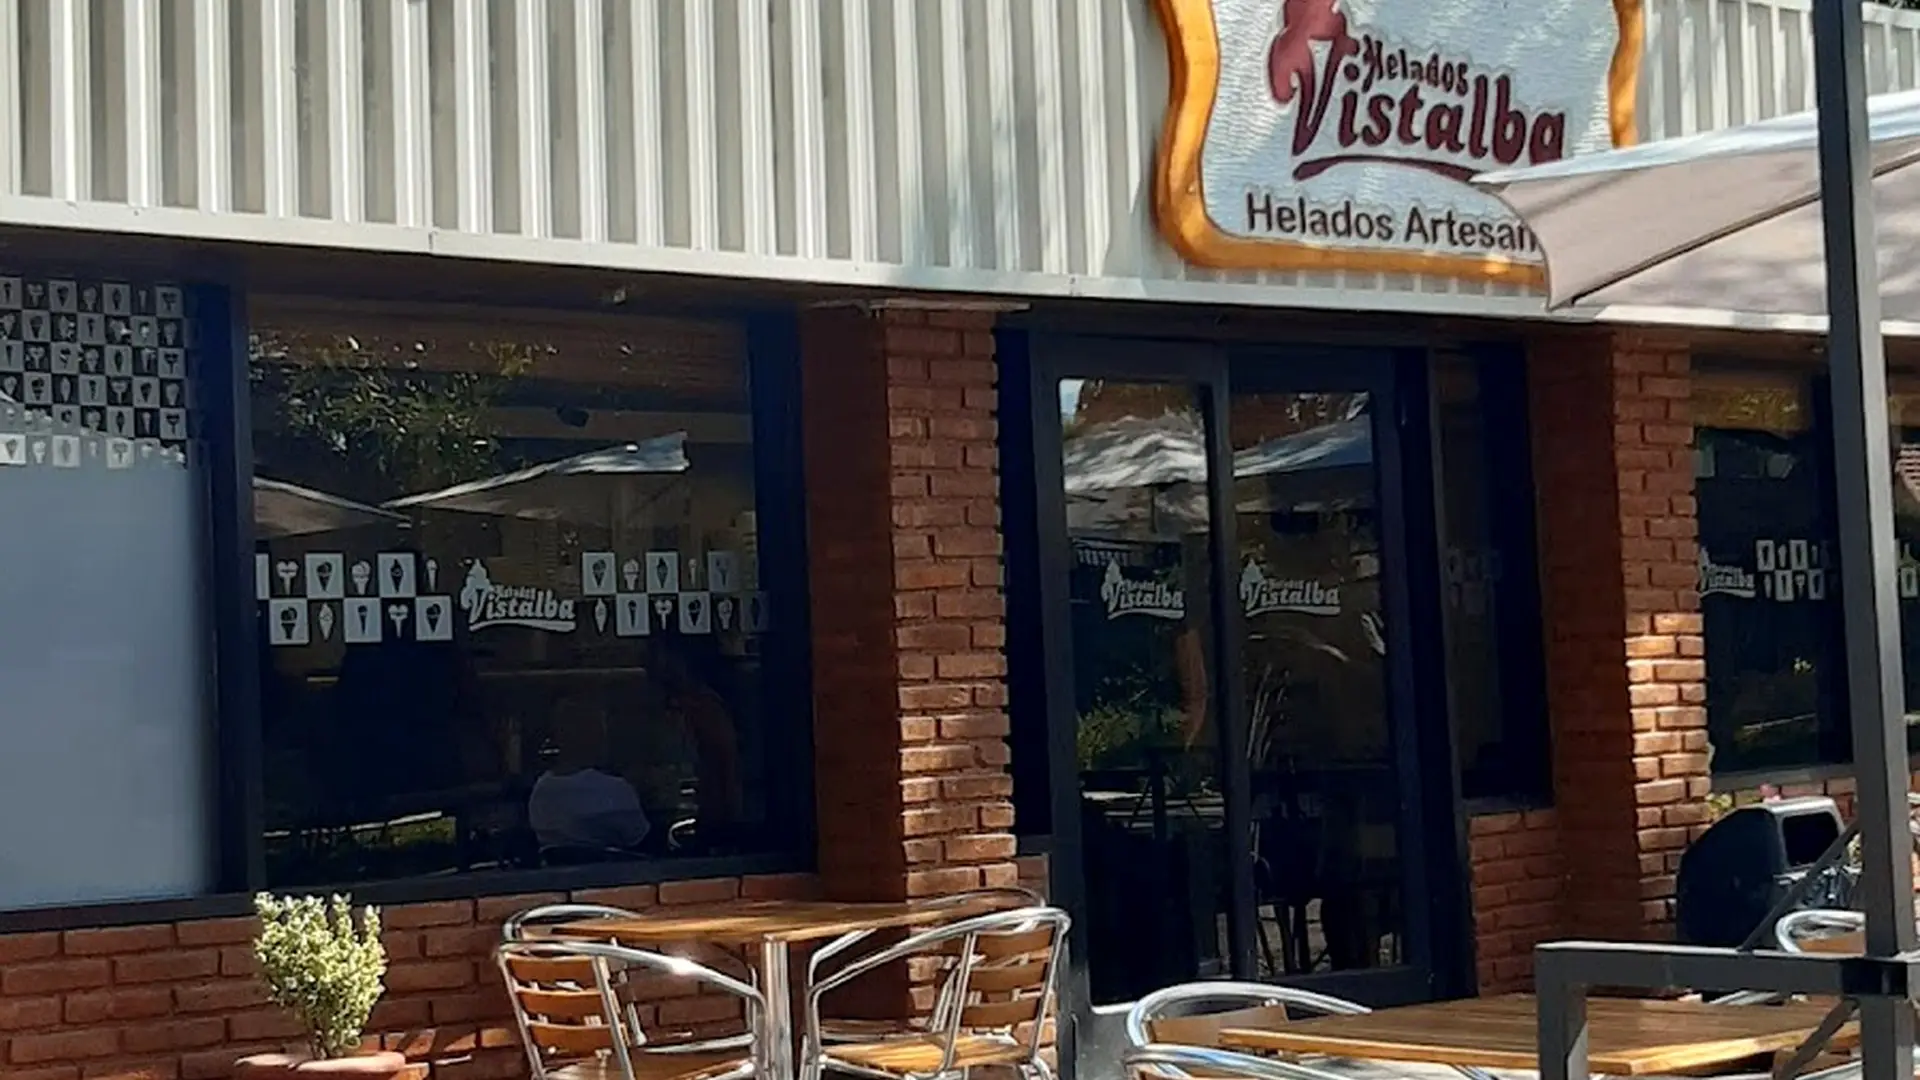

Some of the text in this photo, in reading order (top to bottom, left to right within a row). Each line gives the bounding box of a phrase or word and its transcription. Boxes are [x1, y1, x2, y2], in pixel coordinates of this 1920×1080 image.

[1361, 34, 1469, 97] Helados
[1291, 38, 1566, 165] Vistalba
[1246, 192, 1395, 239] Helados
[468, 587, 576, 624] Vistalba
[1107, 582, 1184, 613] Vistalba
[1245, 580, 1340, 611] Vistalba
